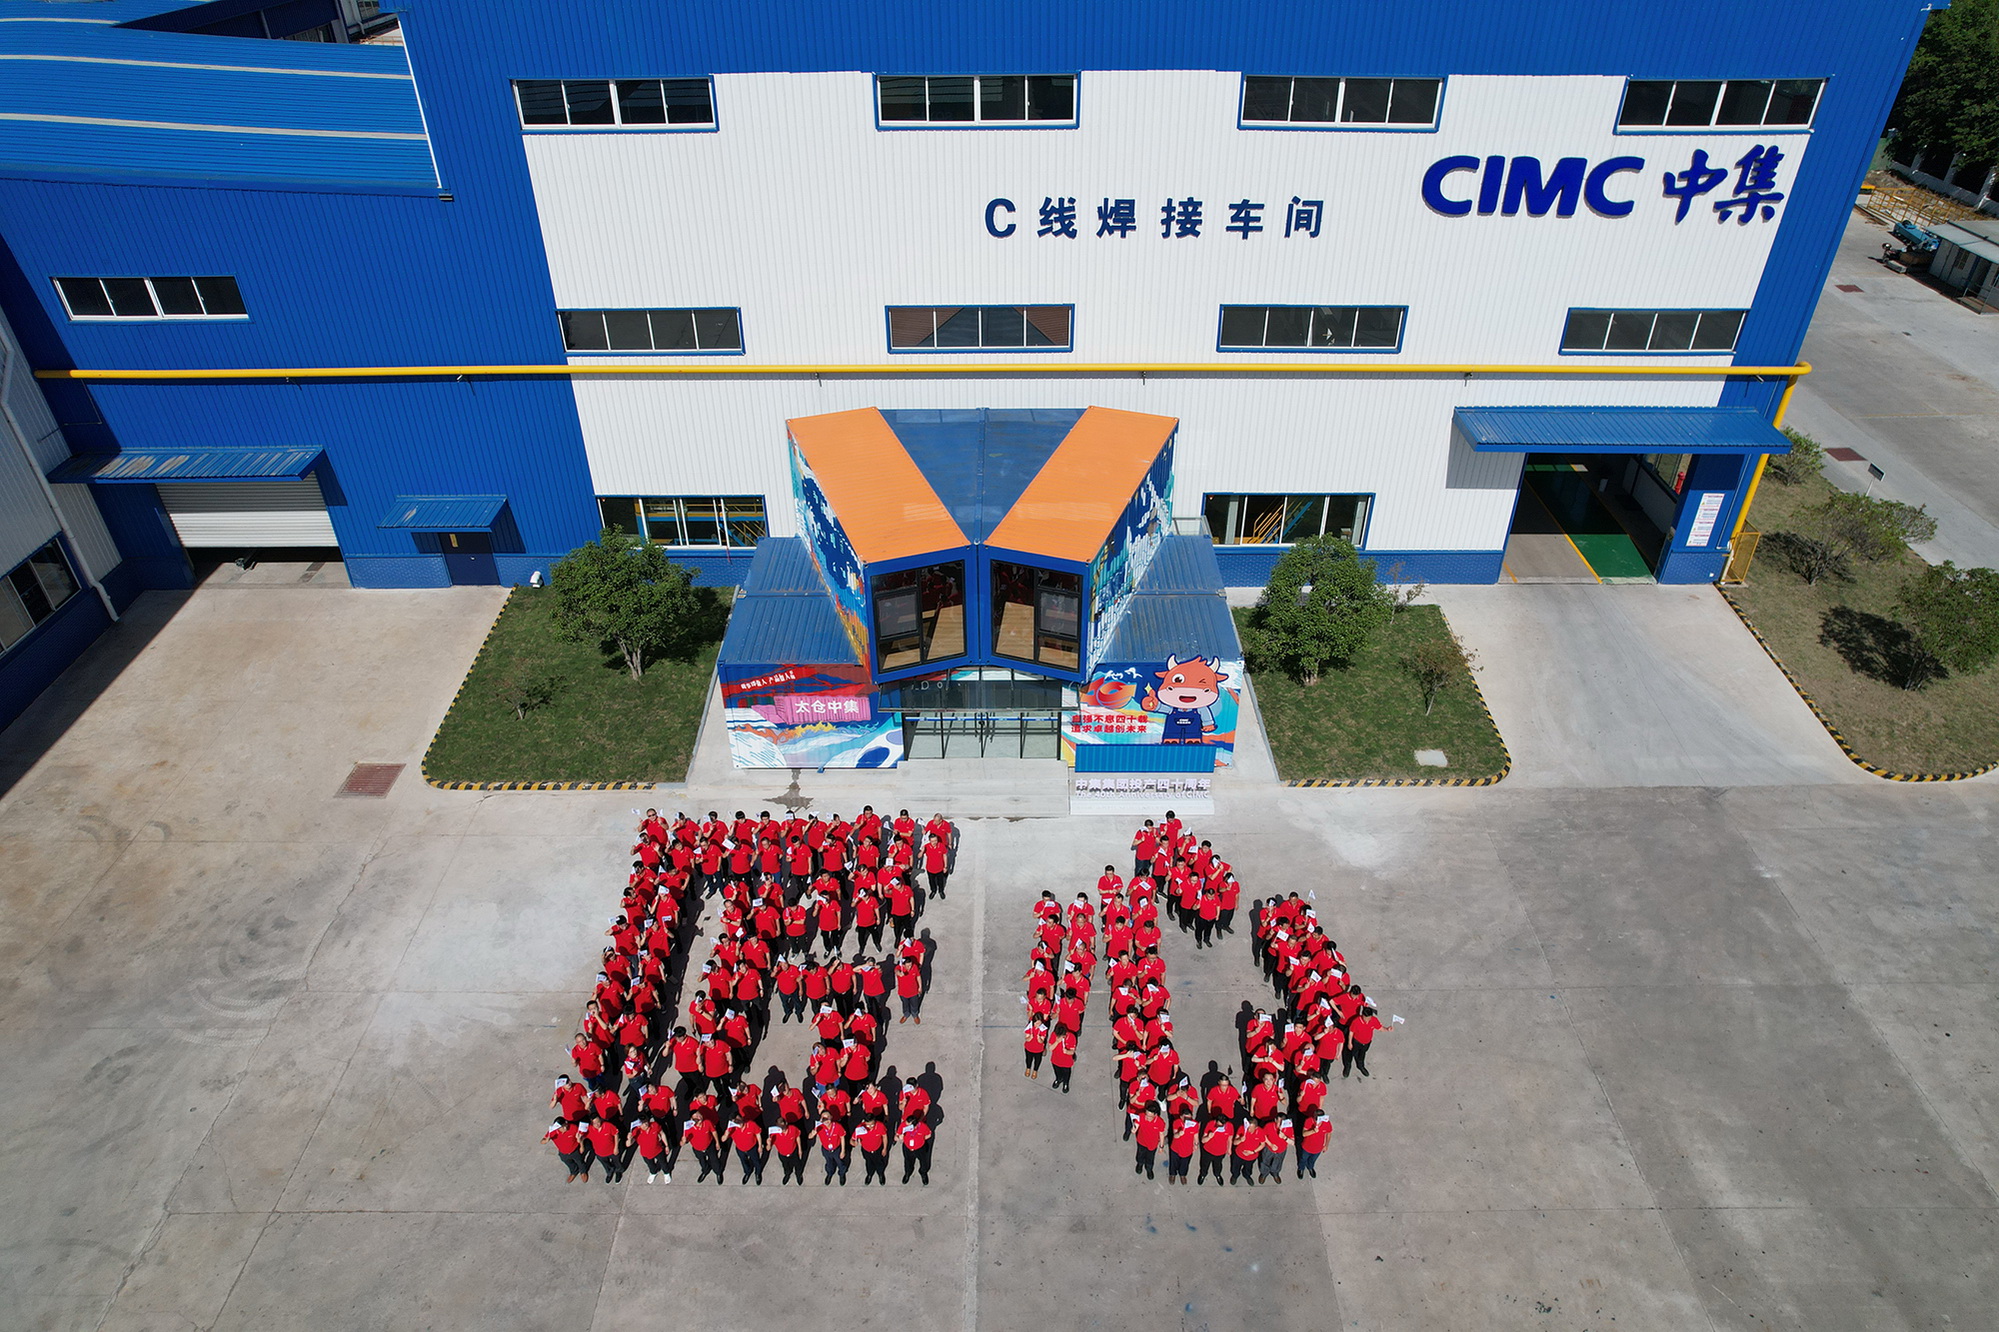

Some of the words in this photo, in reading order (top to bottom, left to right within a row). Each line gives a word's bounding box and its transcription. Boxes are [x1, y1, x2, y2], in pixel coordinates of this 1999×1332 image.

[1422, 154, 1645, 218] CIMC
[1662, 144, 1786, 226] 中集
[985, 196, 1323, 239] C线焊接车间
[794, 699, 859, 714] 太仓中集
[1072, 714, 1148, 723] 自强不息四十载
[1071, 724, 1147, 733] 追求卓越创未来
